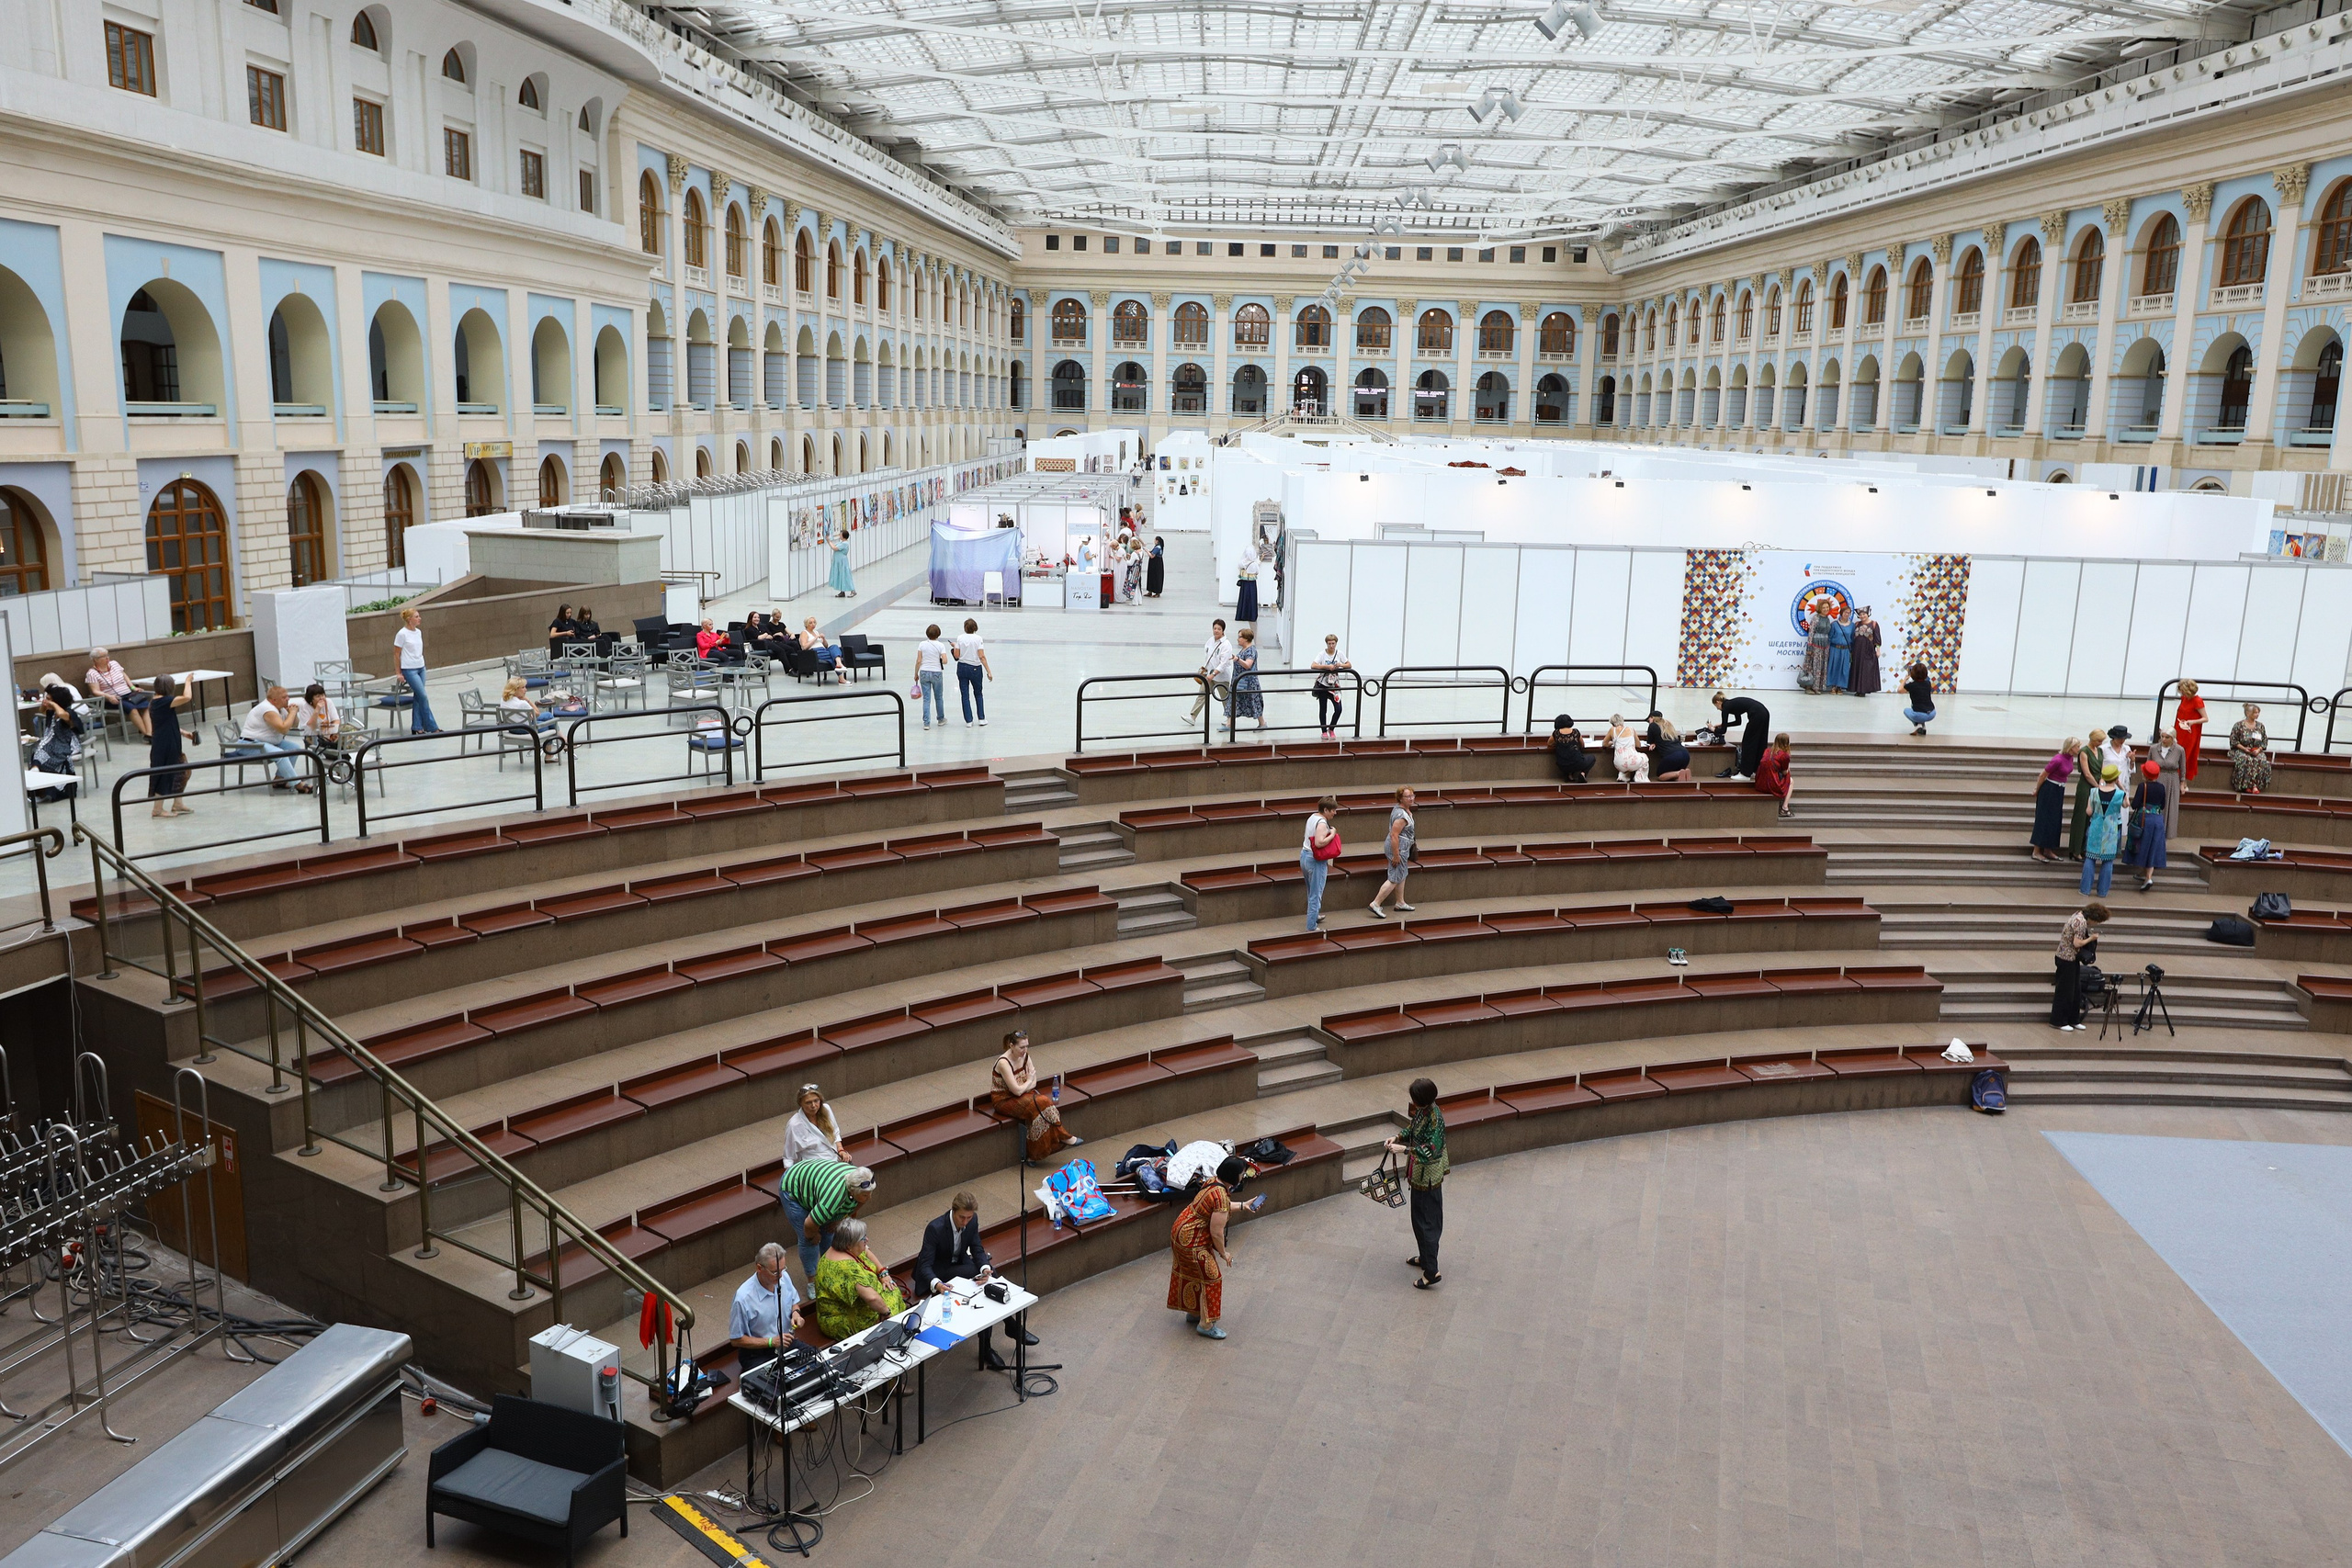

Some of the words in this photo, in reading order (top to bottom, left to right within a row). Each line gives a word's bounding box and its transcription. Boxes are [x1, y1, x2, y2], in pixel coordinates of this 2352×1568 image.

[469, 446, 481, 456] VIP
[1769, 640, 1803, 649] ШЕДЕВРЫ
[1061, 1175, 1096, 1205] OZO
